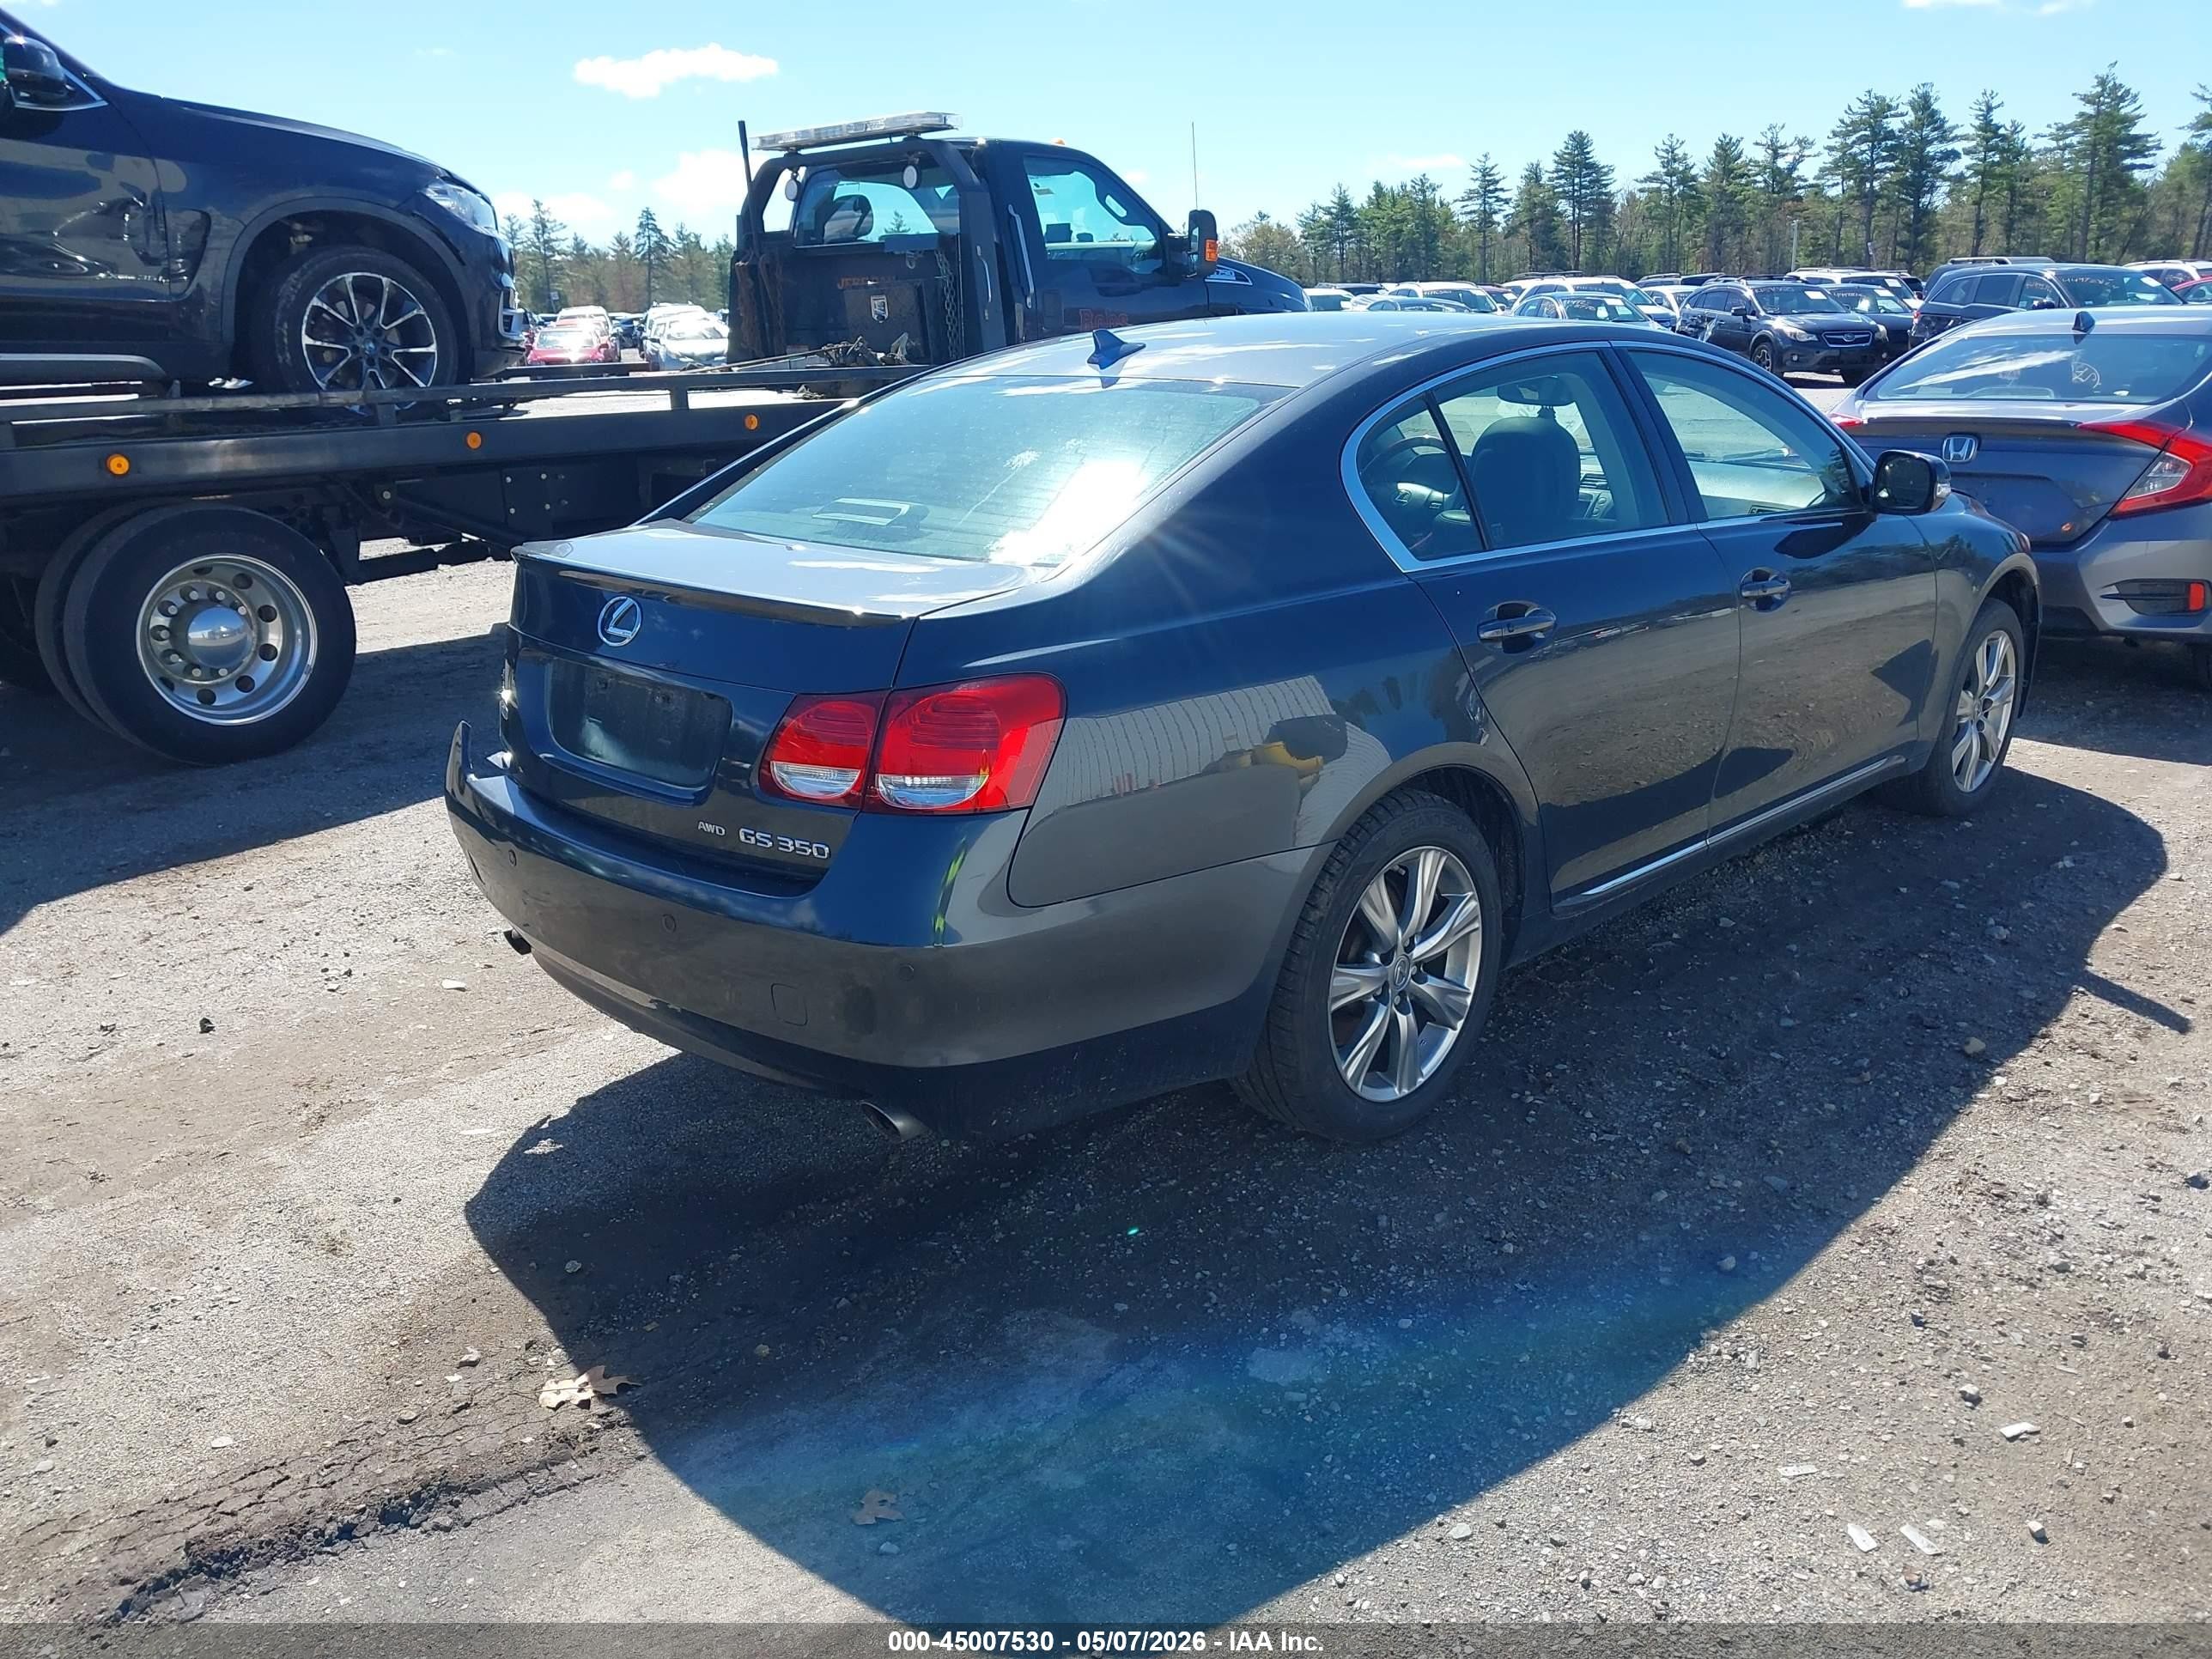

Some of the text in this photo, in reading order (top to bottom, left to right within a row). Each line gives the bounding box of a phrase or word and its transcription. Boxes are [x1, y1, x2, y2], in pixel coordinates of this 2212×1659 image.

[697, 821, 831, 860] AWD GS 350
